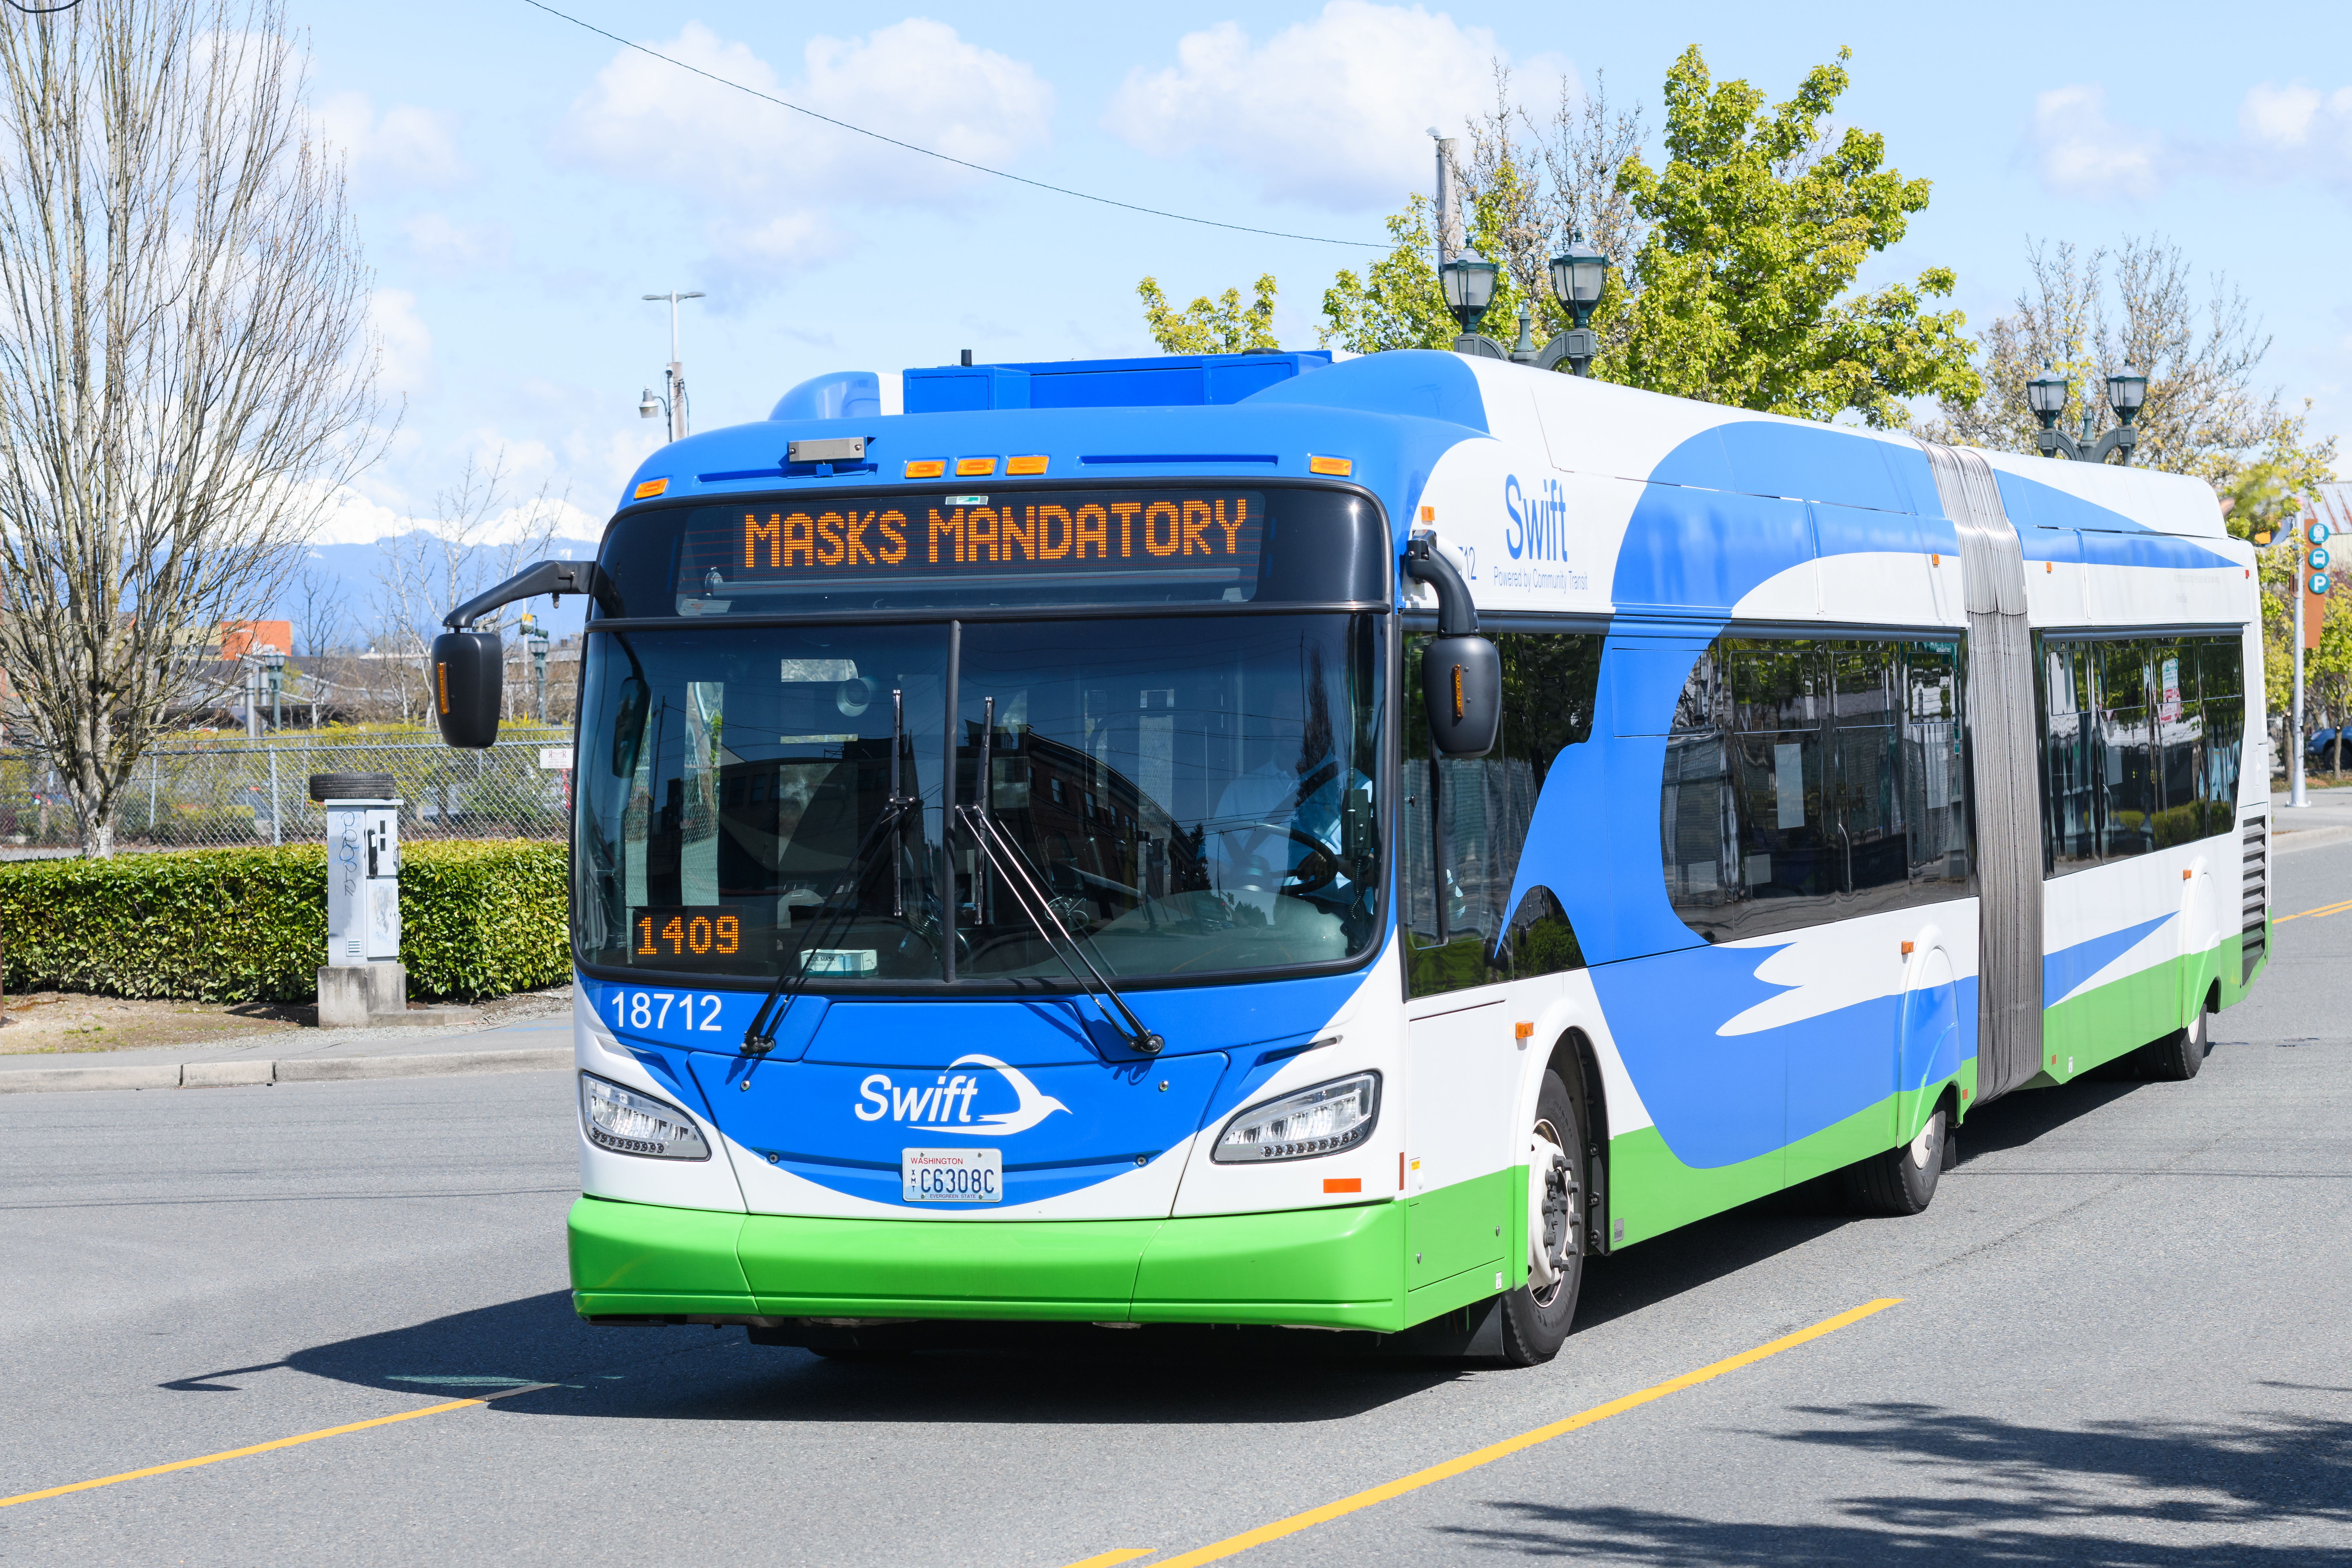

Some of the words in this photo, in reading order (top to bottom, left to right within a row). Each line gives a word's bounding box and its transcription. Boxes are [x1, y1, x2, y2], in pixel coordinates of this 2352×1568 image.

[746, 510, 906, 567] MASKS
[929, 499, 1246, 562] MANDATORY
[1505, 474, 1568, 562] Swift
[1494, 566, 1522, 587] Powered
[1524, 568, 1531, 592] by
[1533, 568, 1567, 594] Community
[1569, 571, 1588, 590] Transit
[2314, 576, 2326, 591] P
[638, 916, 739, 955] 1409
[612, 992, 722, 1031] 18712
[855, 1074, 978, 1122] Swift
[921, 1168, 994, 1193] C6308C
